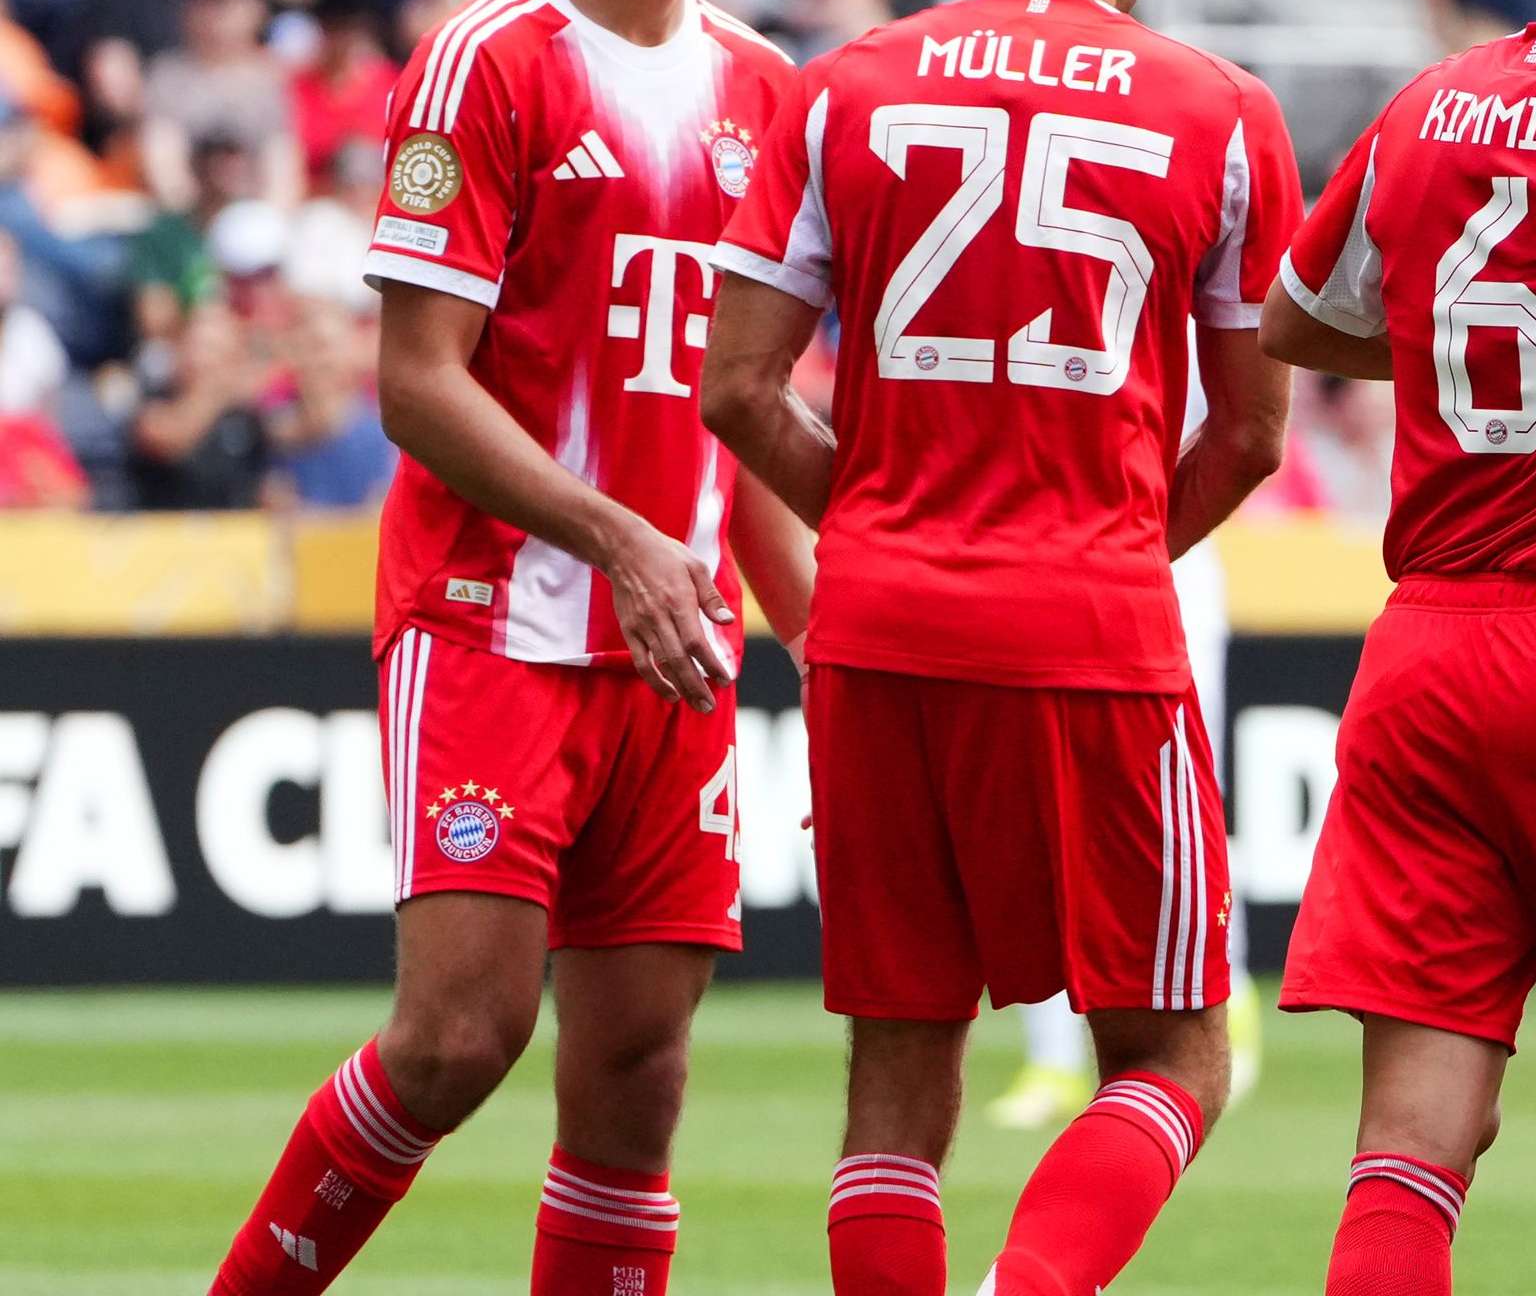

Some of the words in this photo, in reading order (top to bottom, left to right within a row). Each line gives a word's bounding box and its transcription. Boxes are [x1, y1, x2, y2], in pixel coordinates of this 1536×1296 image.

[917, 28, 1136, 95] MÜLLER
[401, 192, 432, 209] FIFA
[869, 104, 1175, 396] 25
[607, 233, 715, 398] T
[440, 813, 454, 829] FC
[454, 805, 494, 830] BAYERN
[612, 1265, 645, 1279] MIA
[612, 1276, 645, 1291] SAN
